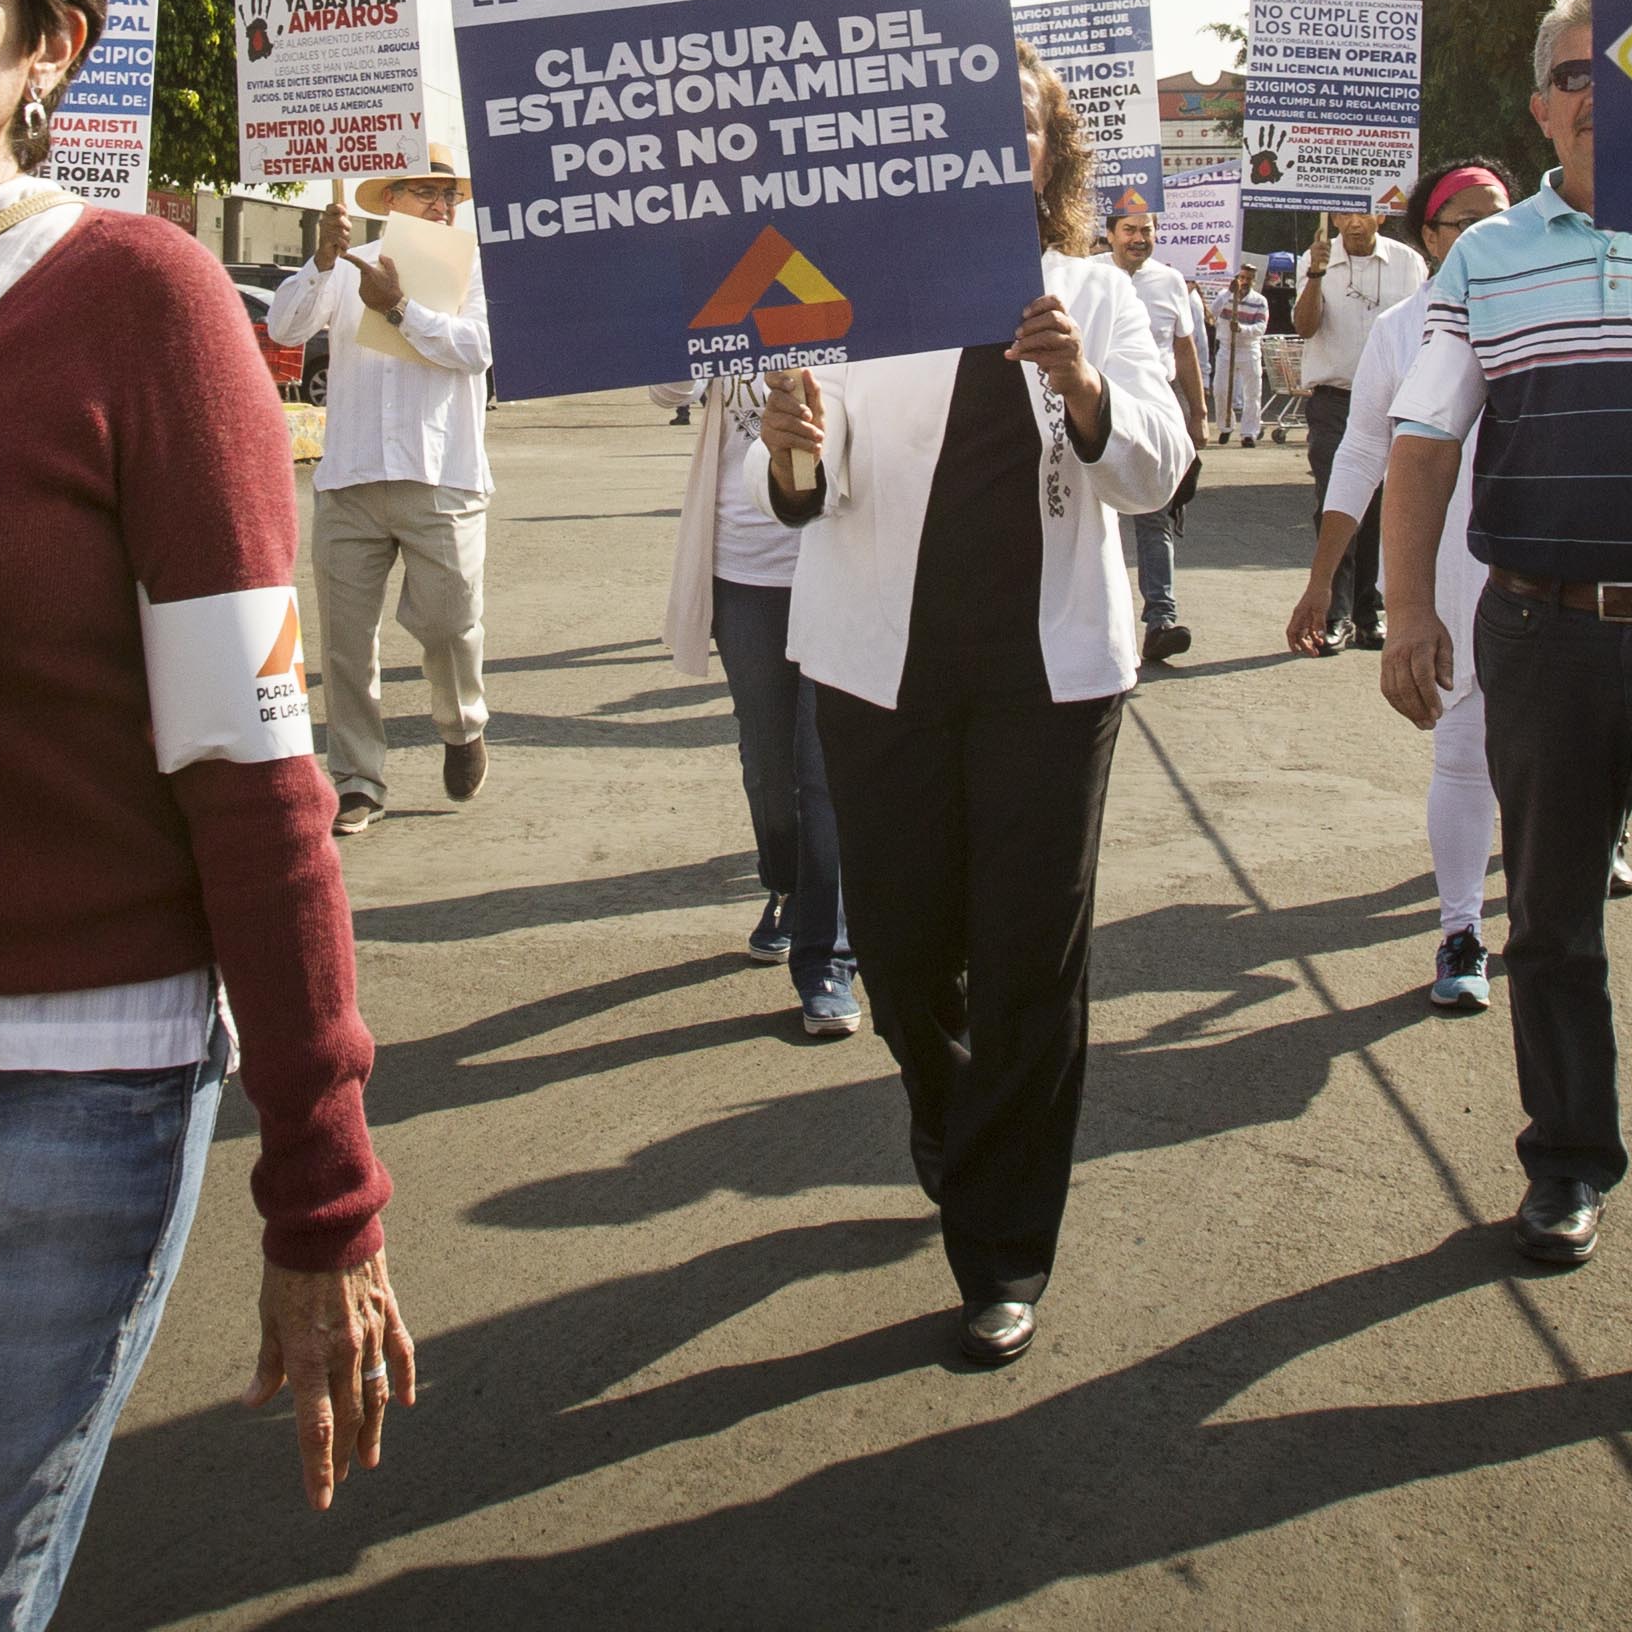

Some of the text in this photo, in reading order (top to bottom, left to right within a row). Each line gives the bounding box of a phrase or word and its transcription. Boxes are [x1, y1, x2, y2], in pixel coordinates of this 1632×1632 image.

[288, 3, 398, 34] AMPAROS
[1053, 6, 1068, 16] DE
[1093, 14, 1128, 26] SIGUE
[1255, 5, 1417, 25] NO CUMPLE CON
[1255, 20, 1416, 41] LOS REQUISITOS
[378, 42, 419, 53] ARGUCIAS
[535, 9, 941, 87] CLAUSURA DEL
[1253, 45, 1416, 64] NO DEBEN OPERAR
[1250, 62, 1417, 79] SIN LICENCIA MUNICIPAL
[486, 44, 999, 136] ESTACIONAMIENTO
[1246, 80, 1420, 99] EXIGIMOS AL MUNICIPIO
[123, 95, 146, 107] DE:
[246, 113, 421, 139] DEMETRIO JUARISTI Y
[1292, 126, 1410, 139] DEMETRIO JUARISTI
[85, 138, 143, 150] GUERRA
[286, 135, 377, 156] JUAN JOSE
[551, 103, 948, 181] POR NO TENER
[264, 152, 407, 176] ESTEFAN GUERRA
[57, 167, 129, 183] ROBAR
[94, 188, 120, 198] 370
[477, 146, 1033, 244] LICENCIA MUNICIPAL
[1181, 200, 1224, 208] ARGUCIAS
[1171, 235, 1230, 245] AMERICAS
[688, 334, 749, 355] PLAZA
[691, 346, 847, 379] DE LAS AMÉRICAS
[257, 683, 294, 701] PLAZA
[260, 706, 277, 722] DE
[281, 703, 299, 718] LAS
